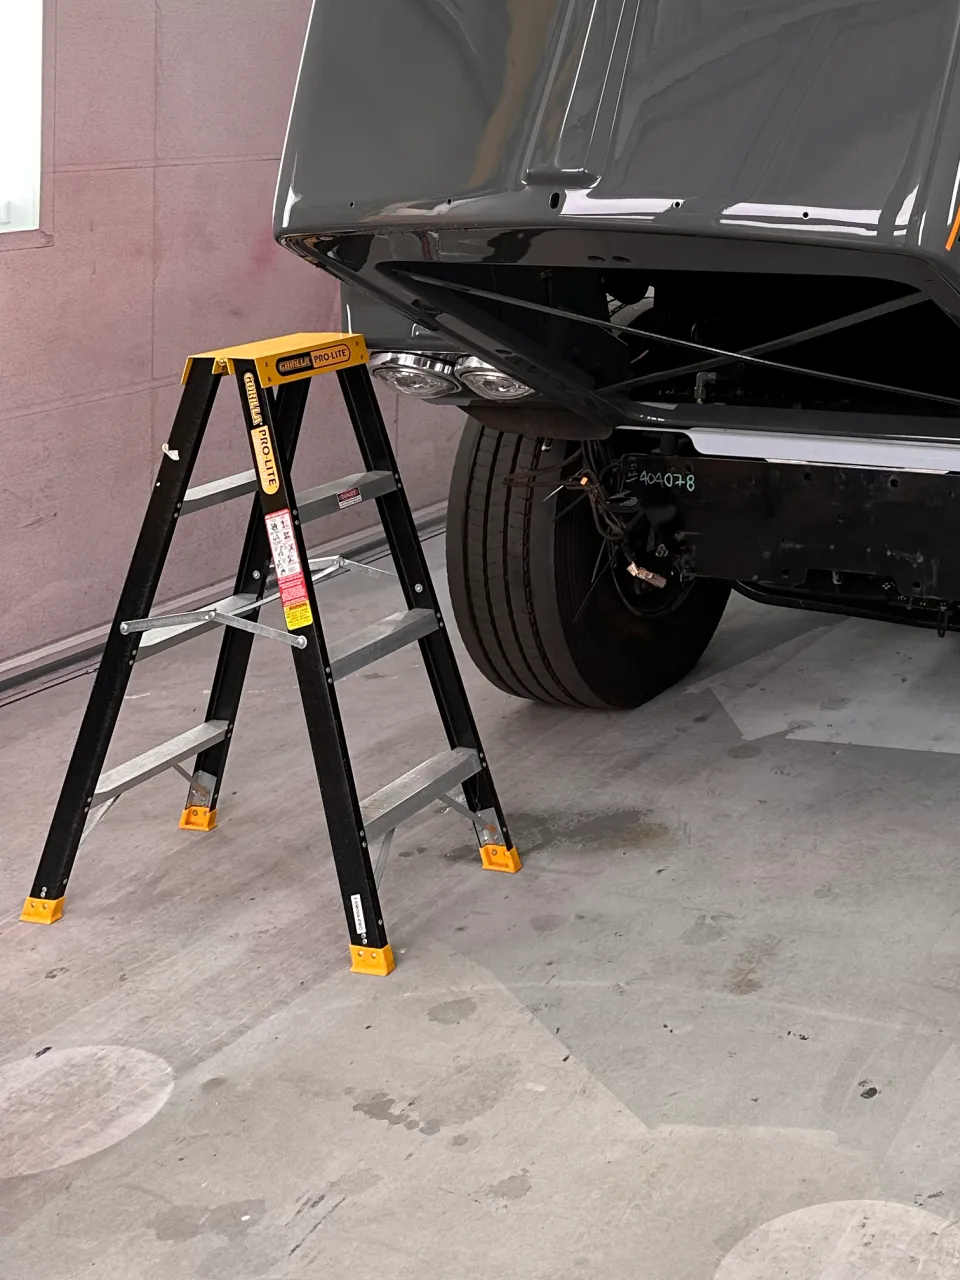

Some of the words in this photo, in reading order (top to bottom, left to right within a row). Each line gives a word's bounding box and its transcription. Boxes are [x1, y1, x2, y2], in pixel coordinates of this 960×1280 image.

[279, 356, 312, 373] GORILLA
[313, 348, 347, 364] PRO-LITE
[243, 371, 263, 426] GORILLA
[258, 428, 278, 487] PRO-LITE
